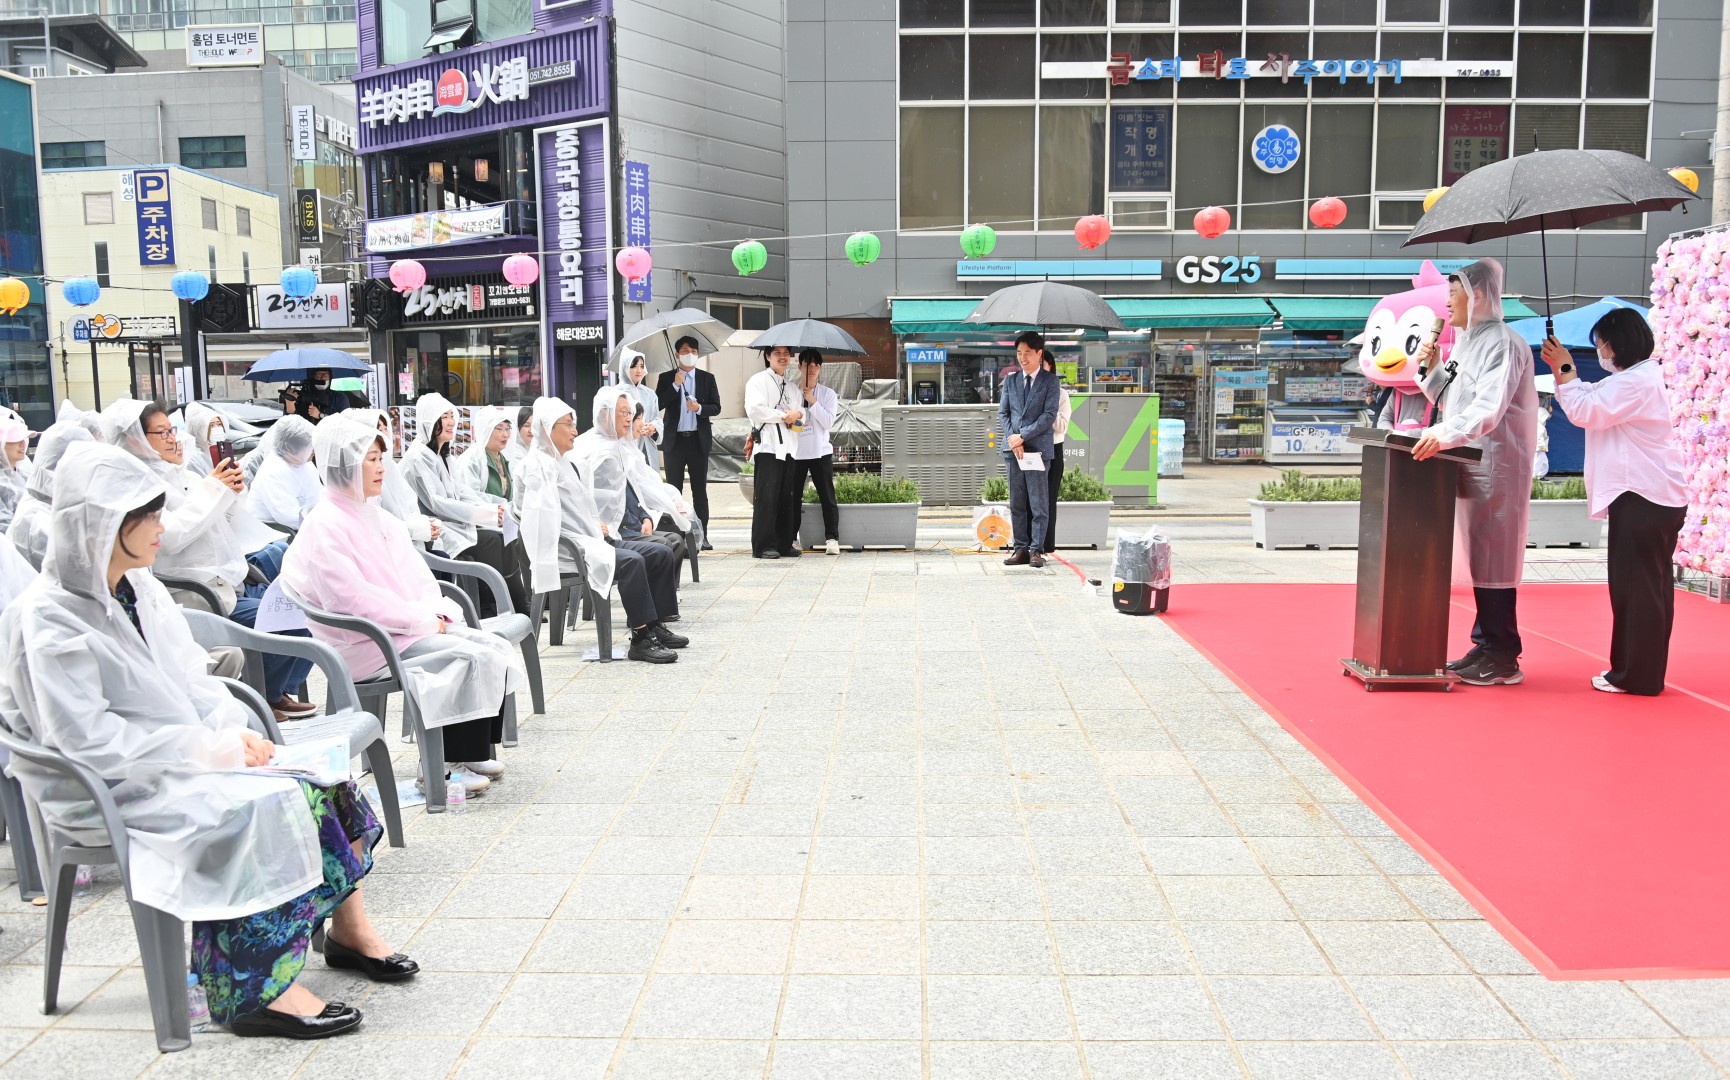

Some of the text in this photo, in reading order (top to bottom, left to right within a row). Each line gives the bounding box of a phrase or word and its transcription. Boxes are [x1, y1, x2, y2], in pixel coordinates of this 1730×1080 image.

[192, 32, 258, 46] 홀덤 토너먼트
[1106, 52, 1182, 86] 금소리
[1197, 49, 1251, 80] 타로
[360, 77, 434, 129] 羊肉串
[472, 56, 530, 109] 火鍋
[529, 64, 571, 81] 051.742.8555
[1454, 138, 1472, 148] 사주
[122, 173, 134, 200] 해성
[140, 175, 164, 199] P
[305, 201, 314, 227] BNS
[555, 128, 584, 306] 중국정통요리
[141, 206, 169, 261] 주차장
[1176, 255, 1262, 284] GS25
[556, 325, 604, 341] 해운대양꼬치
[917, 350, 944, 360] ATM
